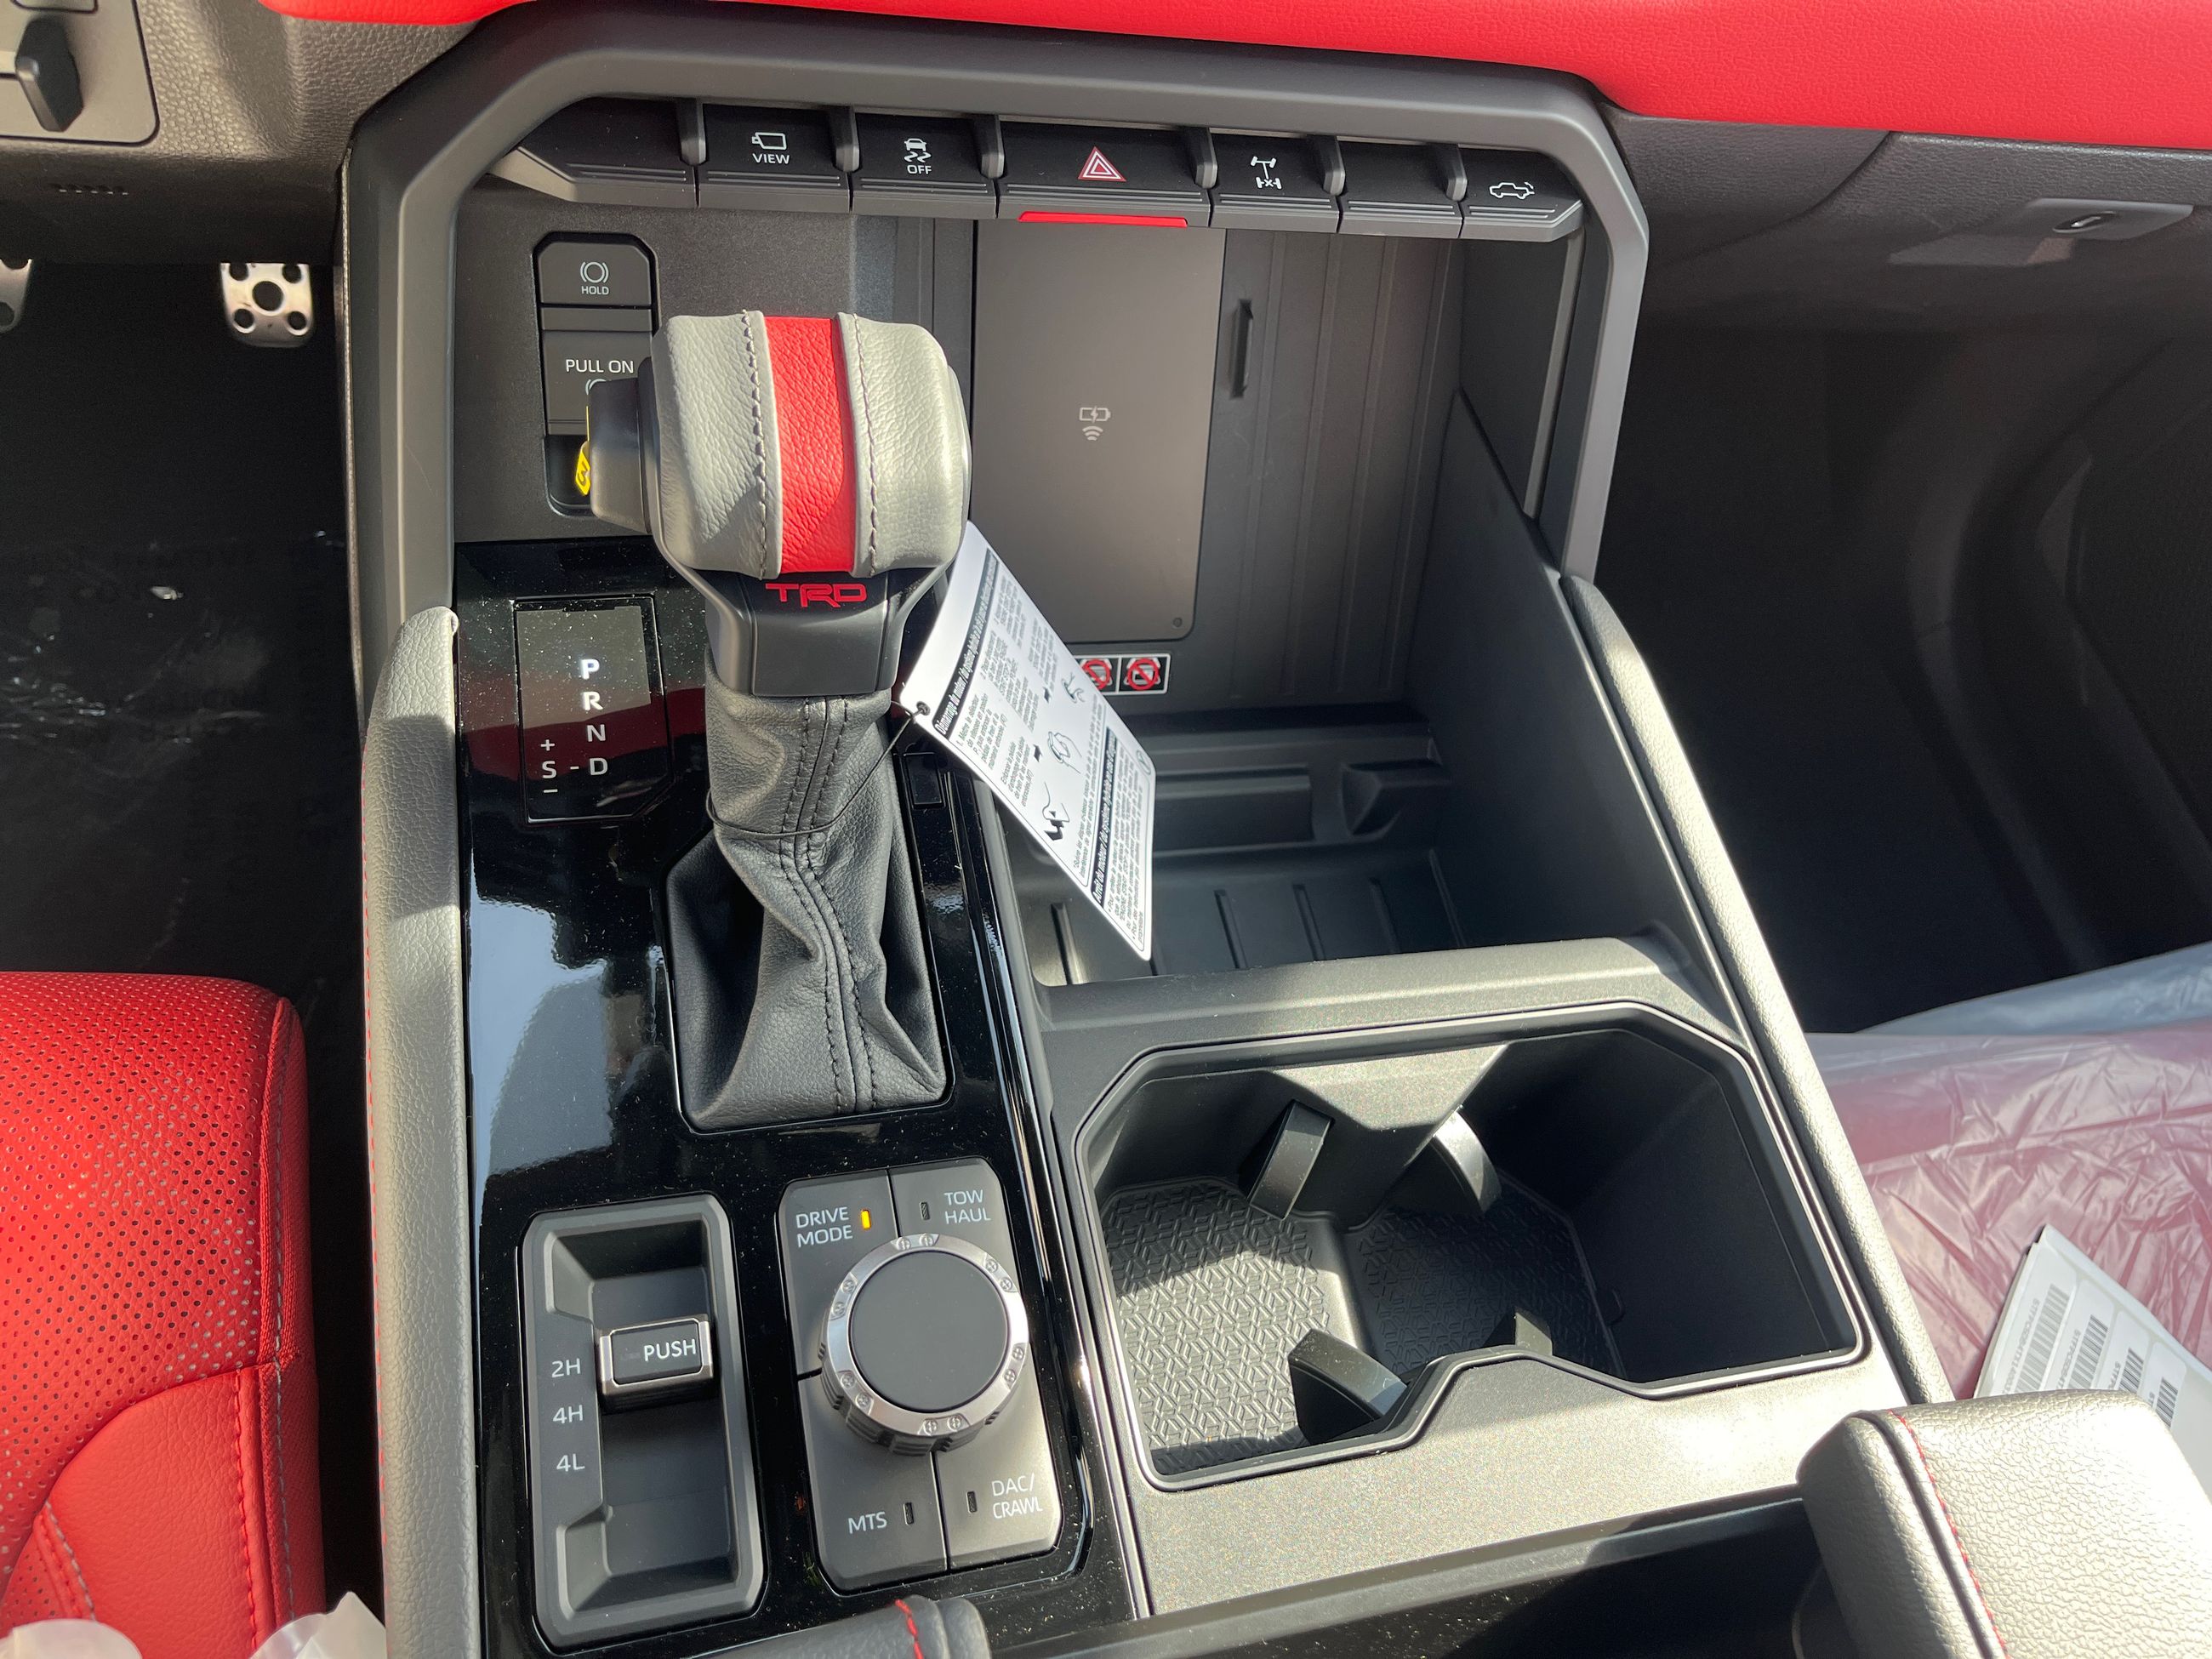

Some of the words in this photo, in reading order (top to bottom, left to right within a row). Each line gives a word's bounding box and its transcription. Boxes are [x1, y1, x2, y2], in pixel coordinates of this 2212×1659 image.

[753, 153, 790, 164] VIEW
[907, 165, 932, 175] OFF
[581, 286, 609, 295] HOLD
[566, 359, 604, 373] PULL
[608, 360, 634, 373] ON
[766, 584, 867, 607] TRD
[579, 658, 600, 679] P
[583, 692, 603, 710] R
[587, 724, 606, 742] N
[542, 761, 557, 778] S
[589, 757, 607, 775] D
[944, 1190, 983, 1206] TOW
[795, 1206, 849, 1228] DRIVE
[944, 1207, 990, 1224] HAUL
[796, 1225, 852, 1247] MODE
[644, 1338, 697, 1361] PUSH
[551, 1358, 581, 1377] 2H
[553, 1405, 584, 1424] 4H
[556, 1453, 584, 1472] 4L
[992, 1473, 1035, 1497] DAC/
[993, 1497, 1043, 1519] CRAWL
[848, 1511, 887, 1534] MTS
